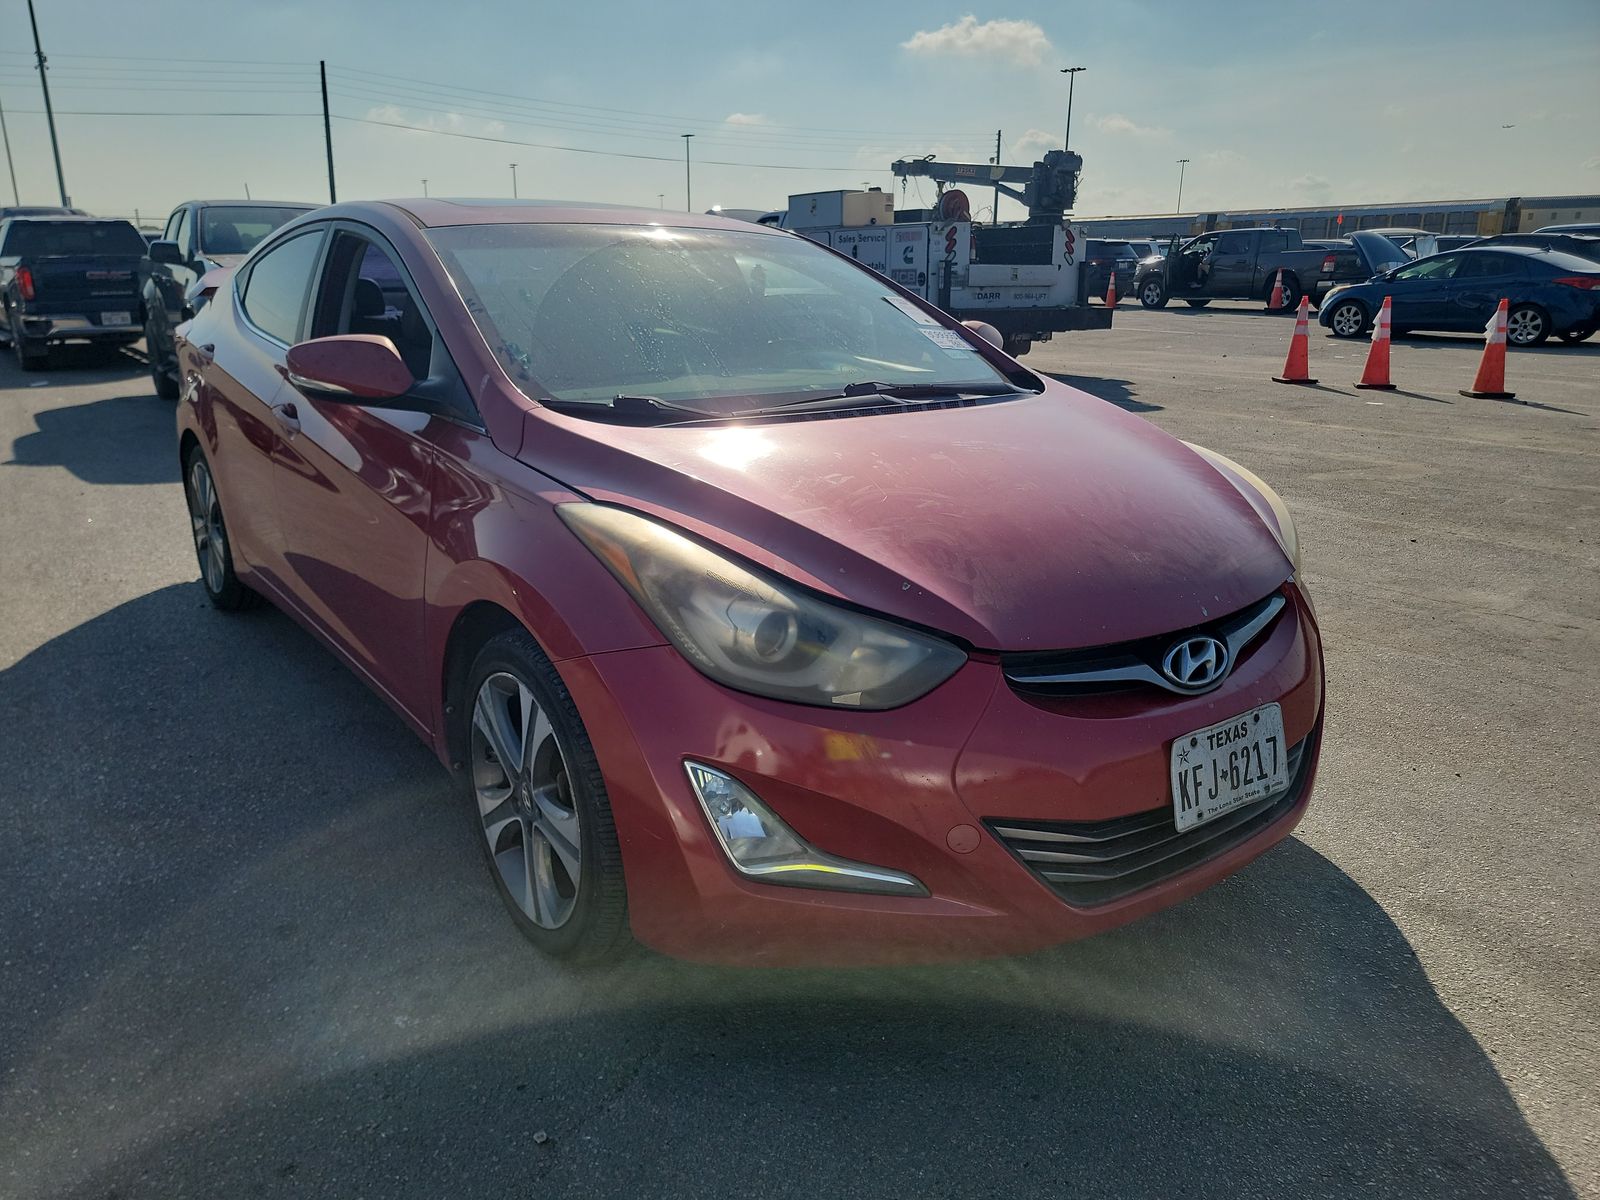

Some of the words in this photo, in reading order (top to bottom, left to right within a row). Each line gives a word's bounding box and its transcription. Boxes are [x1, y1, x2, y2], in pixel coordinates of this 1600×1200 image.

[839, 235, 856, 243] Sales
[859, 234, 886, 243] Service
[977, 293, 1001, 301] DARR
[1207, 722, 1248, 750] TEXAS
[1207, 806, 1218, 814] The
[1232, 794, 1243, 803] Star
[1245, 789, 1260, 798] State
